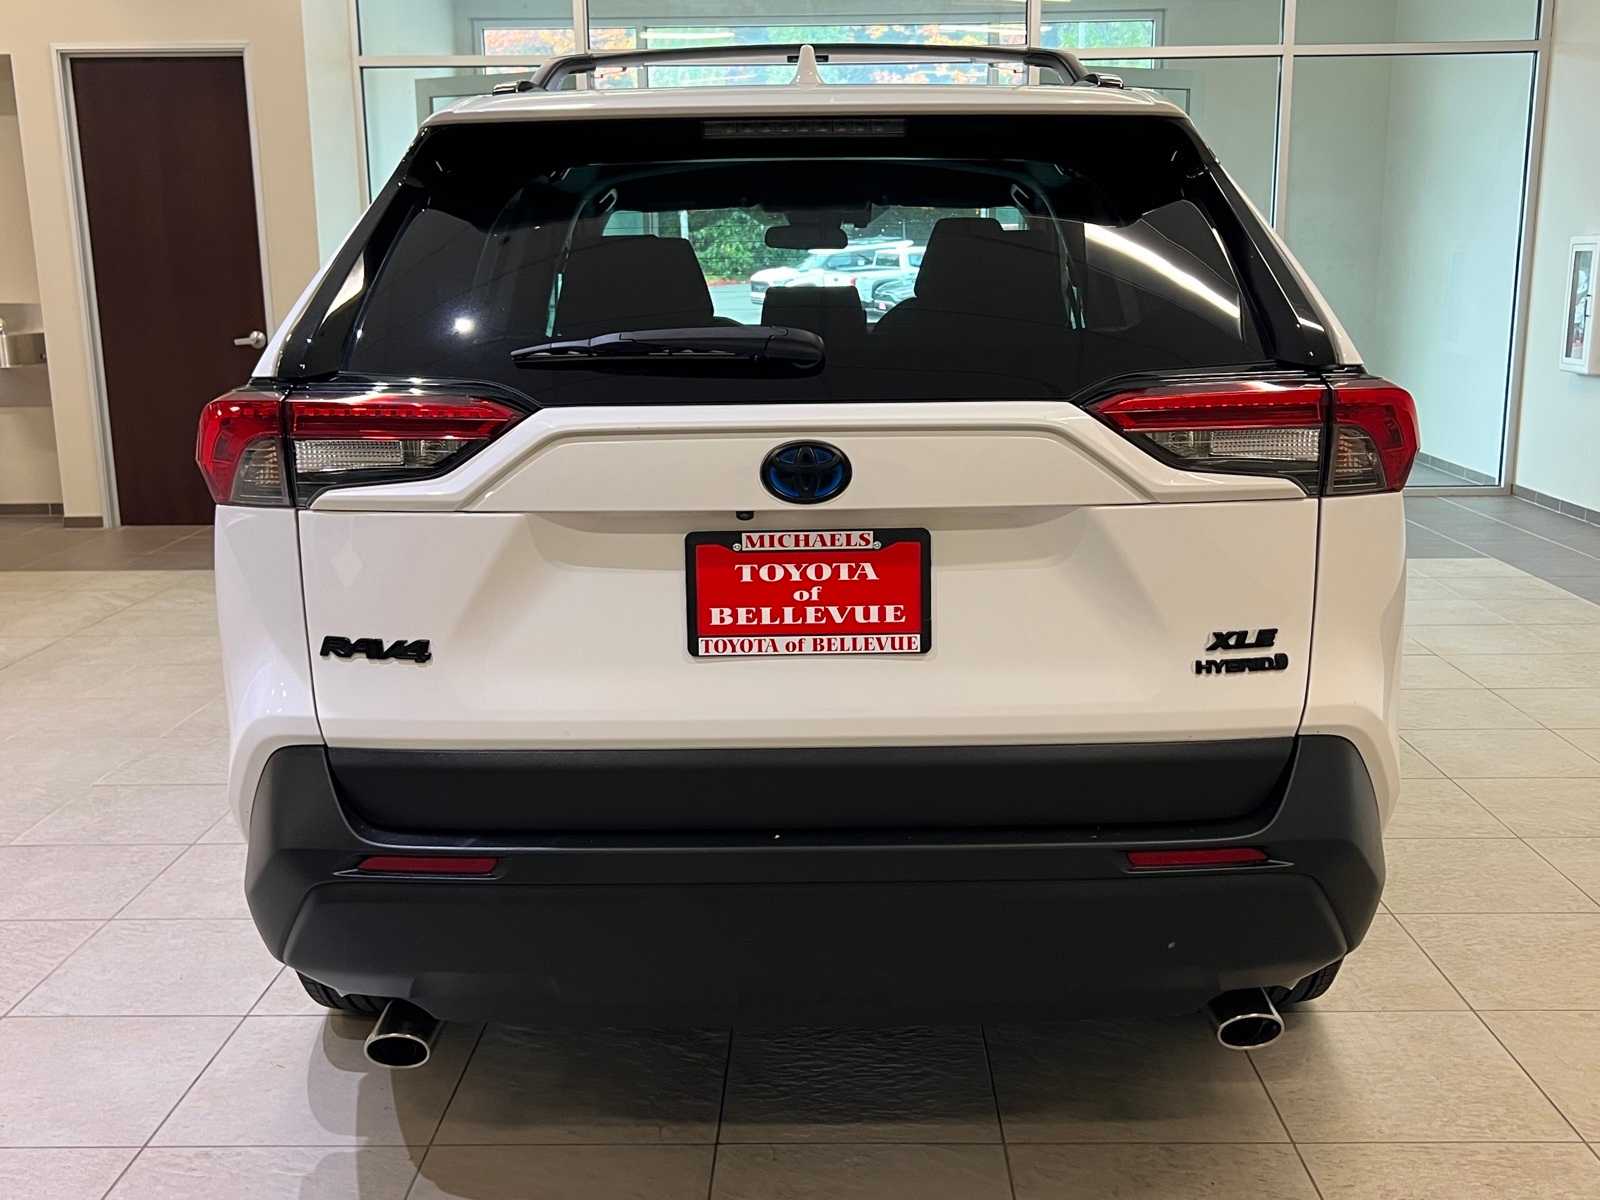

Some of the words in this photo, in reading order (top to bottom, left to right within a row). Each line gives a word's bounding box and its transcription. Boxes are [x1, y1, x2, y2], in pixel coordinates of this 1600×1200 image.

[745, 533, 871, 548] MICHAELS
[734, 563, 879, 582] TOYOTA
[793, 586, 822, 601] of
[709, 605, 906, 625] BELLEVUE
[701, 638, 780, 654] TOYOTA
[785, 638, 805, 652] of
[813, 636, 918, 652] BELLEVUE
[1206, 628, 1278, 651] XLE
[320, 636, 432, 663] RAV4
[1195, 657, 1274, 674] HYBRID
